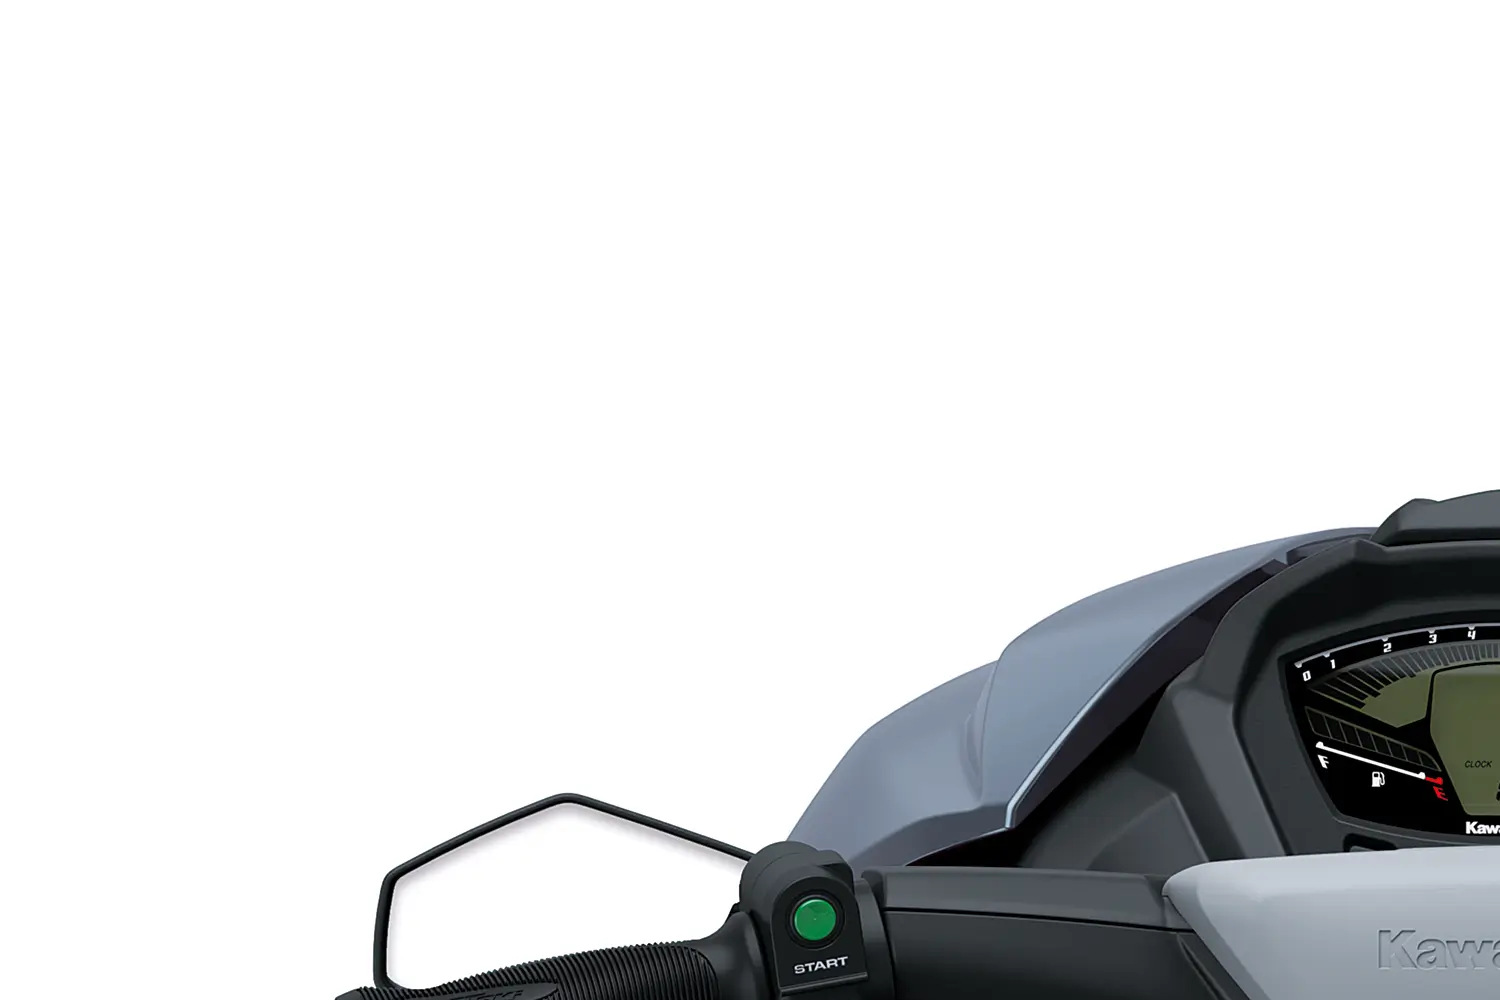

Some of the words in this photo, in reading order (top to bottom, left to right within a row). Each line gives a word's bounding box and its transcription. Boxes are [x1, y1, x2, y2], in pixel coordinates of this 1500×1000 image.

[1303, 670, 1311, 682] 0
[1330, 659, 1336, 669] 1
[1383, 643, 1392, 653] 2
[1429, 634, 1437, 644] 3
[1467, 630, 1476, 640] 4
[1318, 754, 1329, 768] F
[1464, 760, 1492, 768] CLOCK
[1433, 786, 1448, 801] E
[794, 956, 848, 974] START
